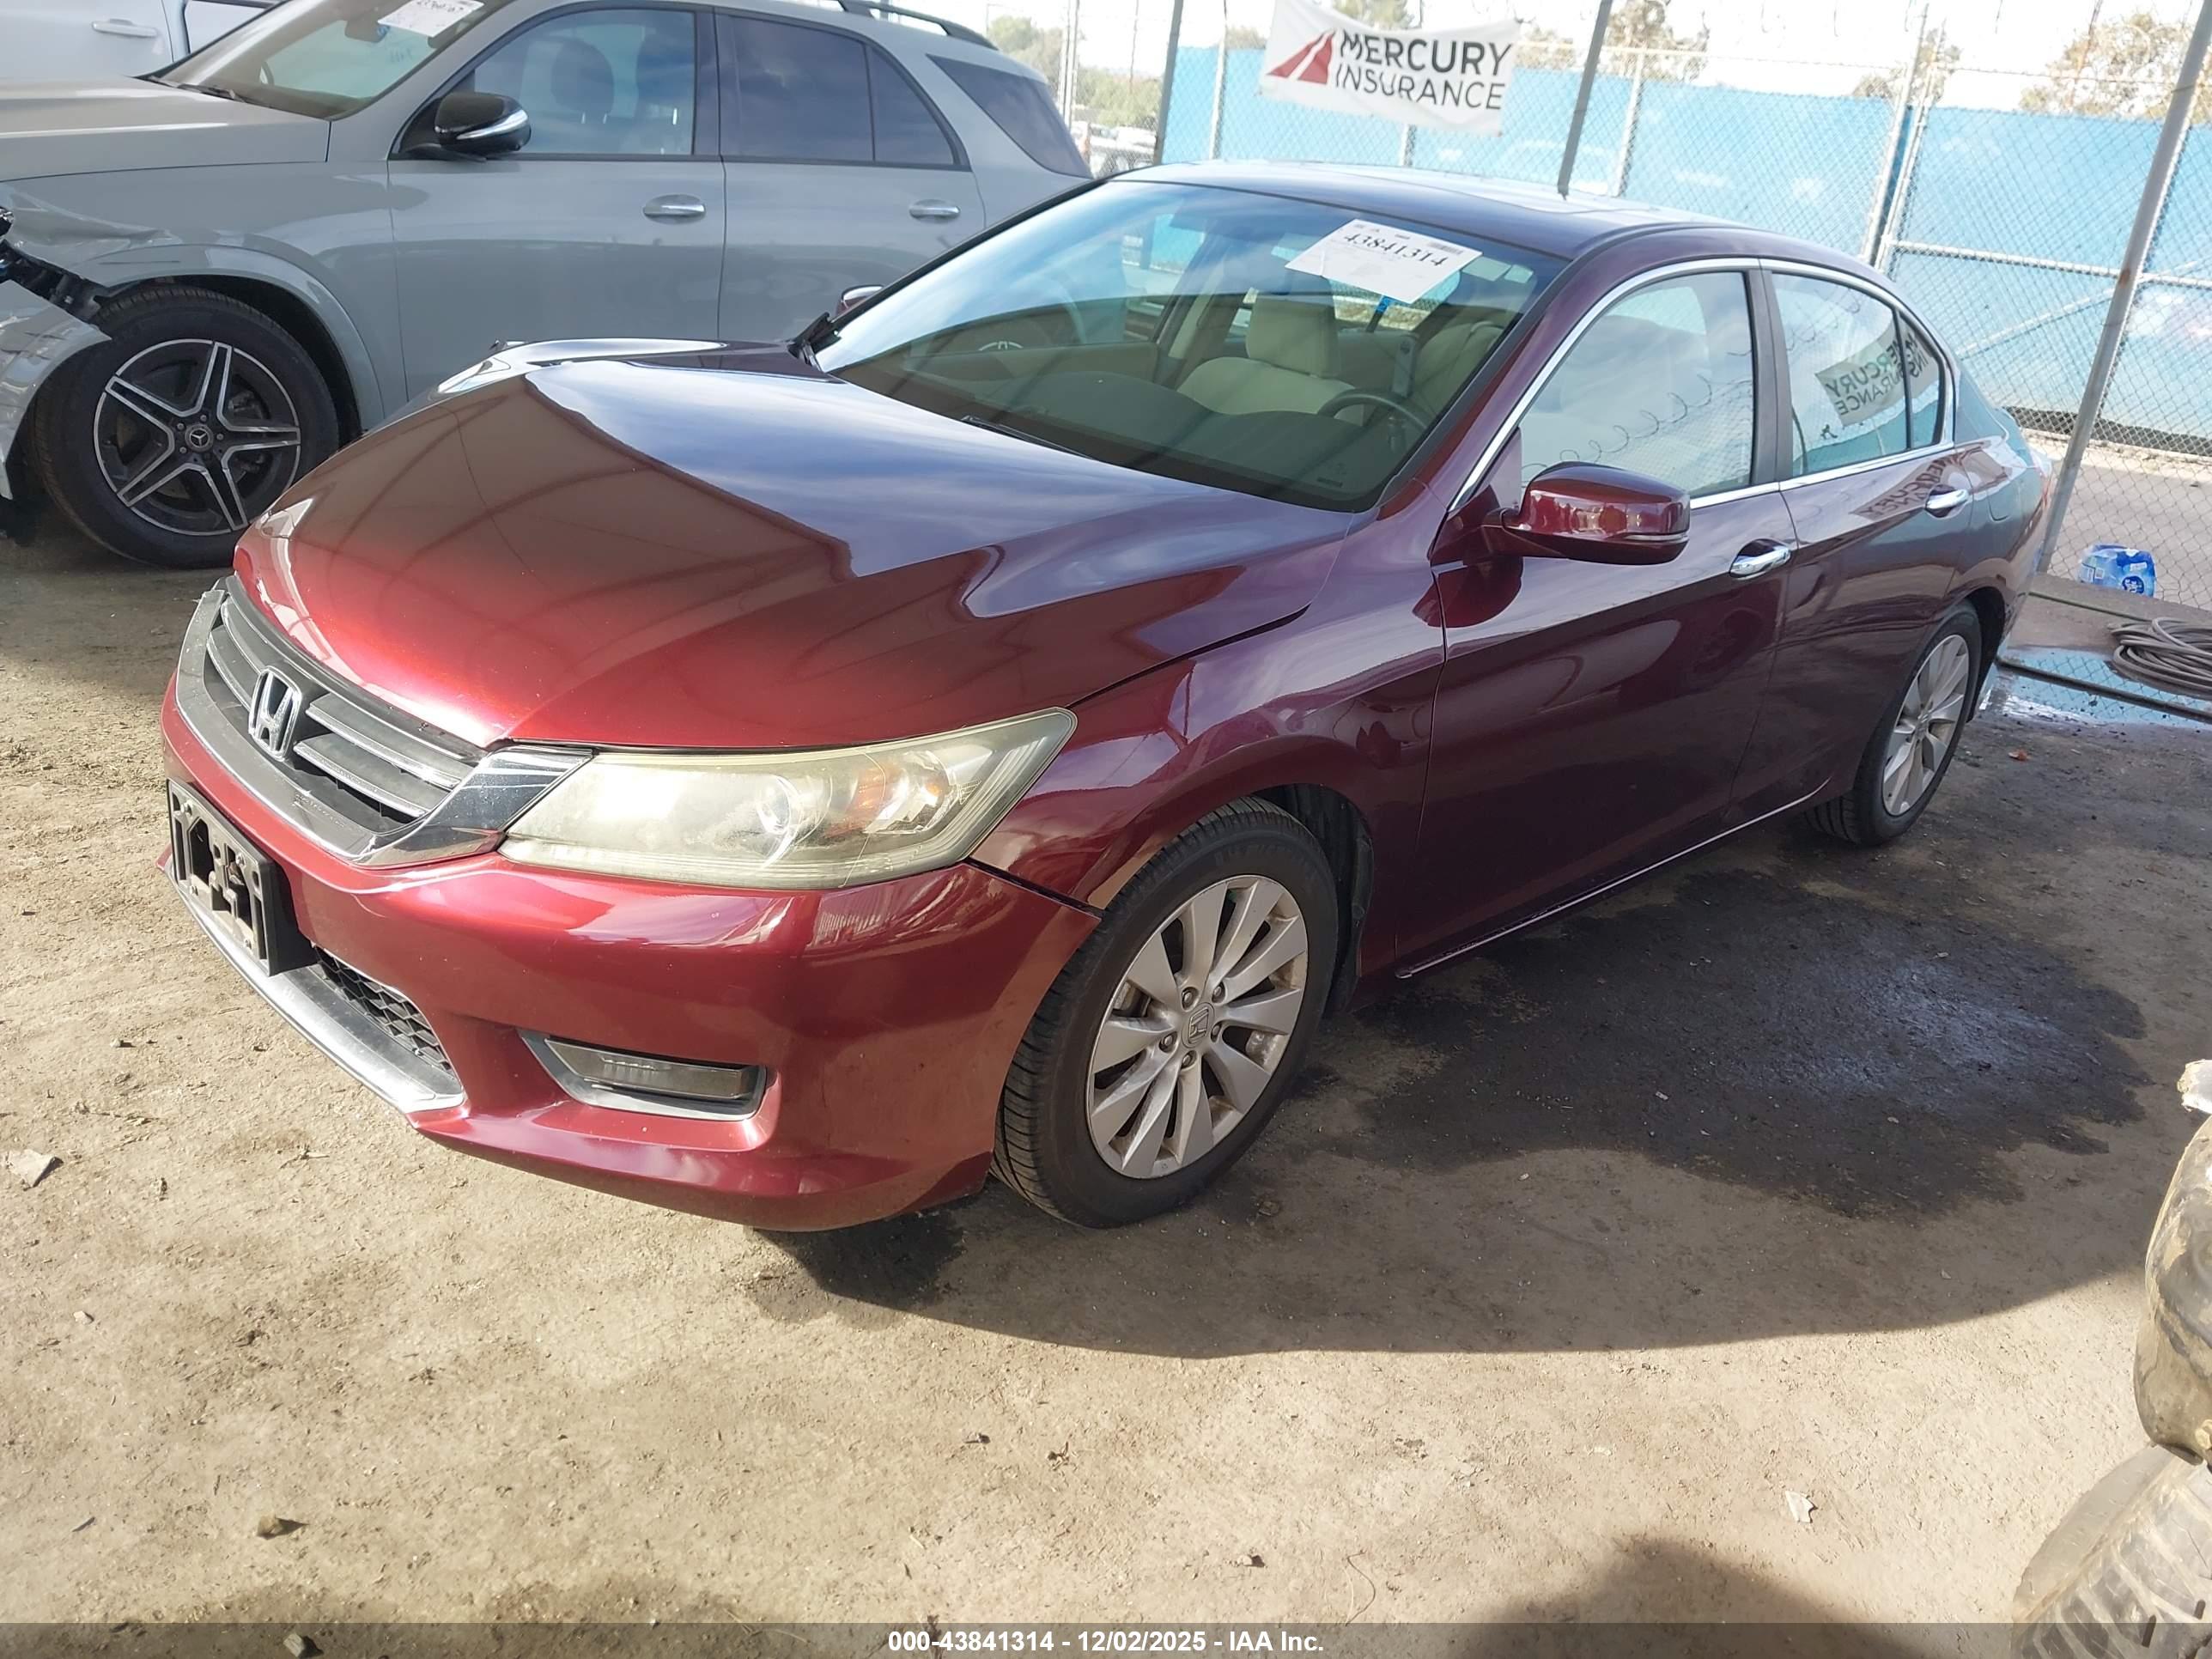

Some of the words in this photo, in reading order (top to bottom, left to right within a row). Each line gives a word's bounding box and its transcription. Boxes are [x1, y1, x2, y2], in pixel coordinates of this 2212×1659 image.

[1340, 29, 1512, 76] MERCURY
[1336, 64, 1505, 110] INSURANCE
[1344, 234, 1448, 265] 43841314
